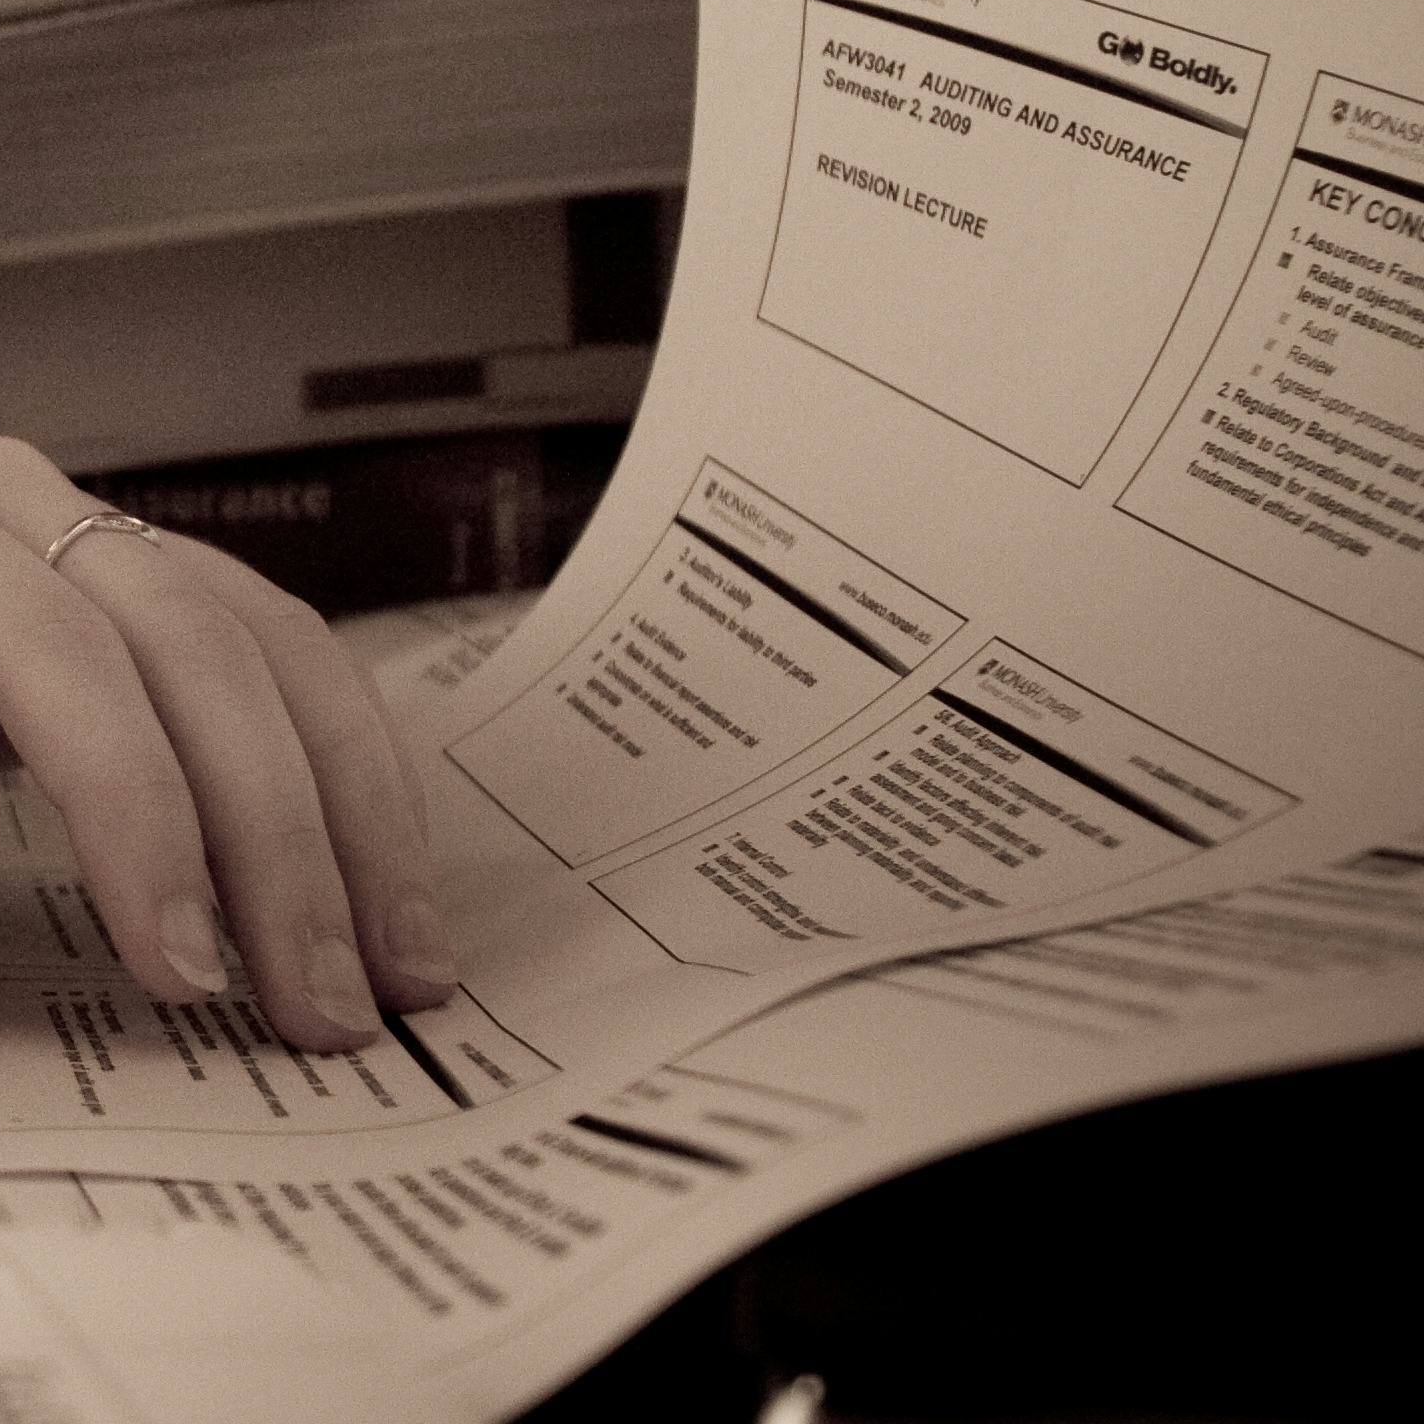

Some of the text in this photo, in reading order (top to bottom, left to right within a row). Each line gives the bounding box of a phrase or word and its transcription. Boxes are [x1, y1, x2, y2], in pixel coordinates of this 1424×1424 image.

[1148, 46, 1238, 95] Boldly.
[822, 39, 1191, 183] AFW3041 AUDITING AND ASSURANCE
[823, 68, 972, 135] Semester 2, 2009
[817, 153, 989, 239] REVISION LECTURE
[1309, 179, 1363, 215] KEY
[1305, 232, 1385, 273] Assurance
[1308, 264, 1354, 293] Relate
[1296, 285, 1334, 311] level
[1334, 303, 1354, 318] of
[1286, 345, 1337, 376] Review
[1300, 320, 1338, 346] Audit
[1232, 387, 1305, 434] Regulatory
[1304, 421, 1392, 468] Background
[1391, 463, 1422, 483] and
[1201, 441, 1284, 488] requirements
[1284, 478, 1306, 496] for
[1305, 489, 1398, 539] independence
[1216, 415, 1416, 516] Relate to Corporations Act and
[1187, 460, 1372, 557] fundamental ethical principles
